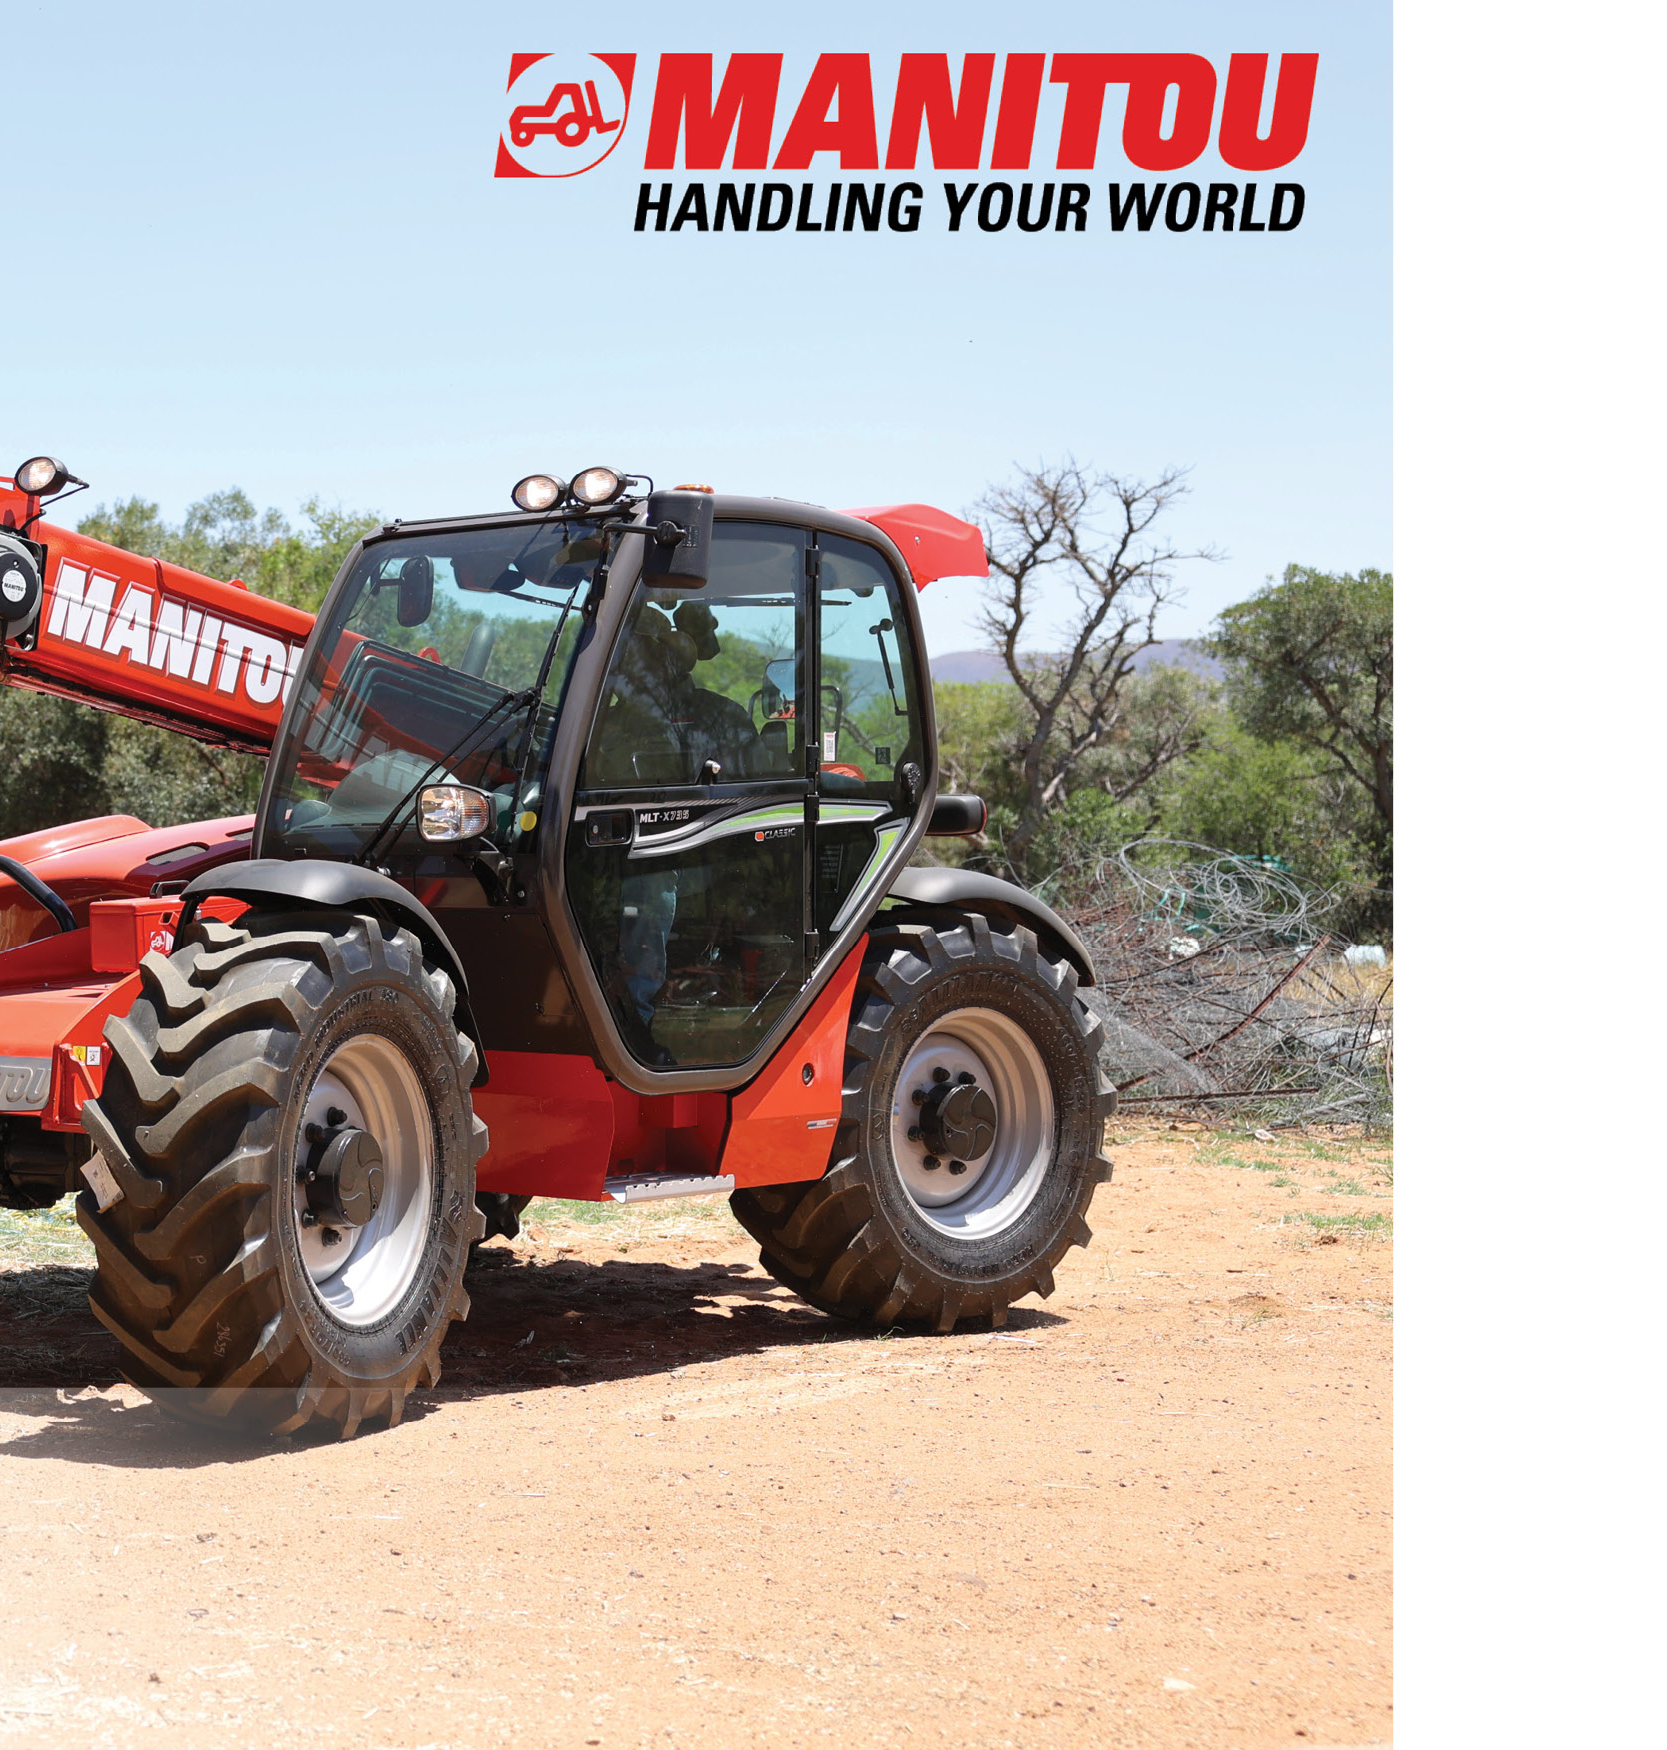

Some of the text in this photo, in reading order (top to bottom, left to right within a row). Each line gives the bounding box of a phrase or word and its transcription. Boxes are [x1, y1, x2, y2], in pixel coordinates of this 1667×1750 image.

[4, 582, 24, 592] MANITOU
[764, 827, 796, 840] CLASSIC
[394, 1216, 458, 1358] ALLIANCE
